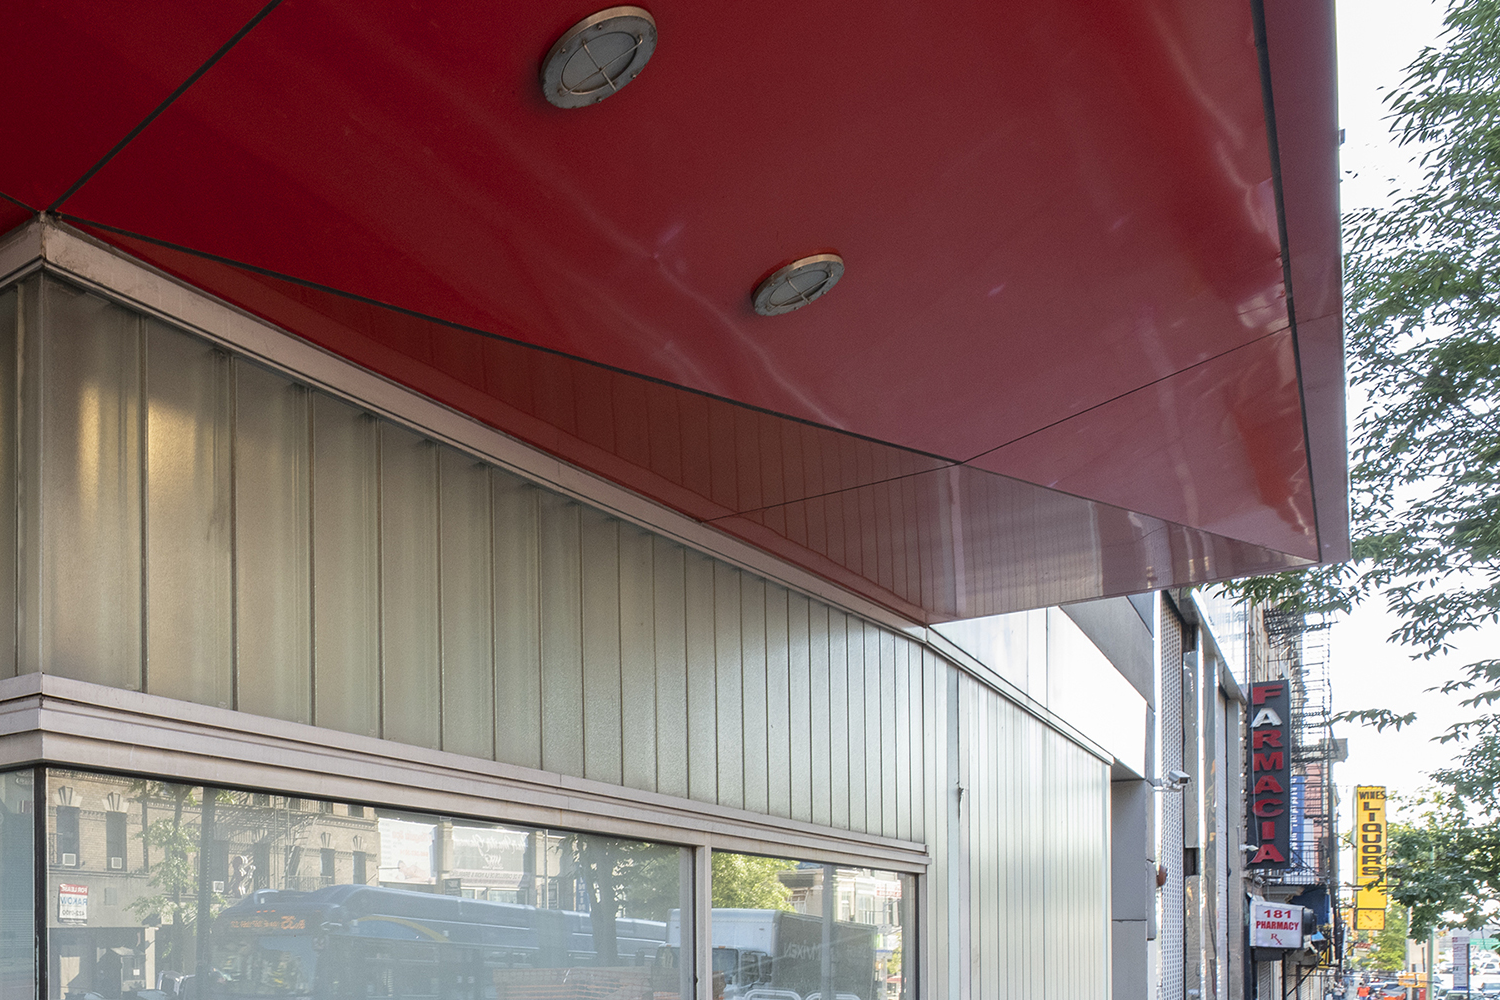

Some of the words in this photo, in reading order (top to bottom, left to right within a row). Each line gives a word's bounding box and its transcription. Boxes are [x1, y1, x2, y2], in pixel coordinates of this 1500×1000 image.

[1250, 684, 1285, 863] FARMACIA
[1358, 790, 1385, 800] WINES
[1362, 802, 1382, 877] LIQUORS
[1264, 910, 1292, 919] 181
[1256, 920, 1300, 931] PHARMACY
